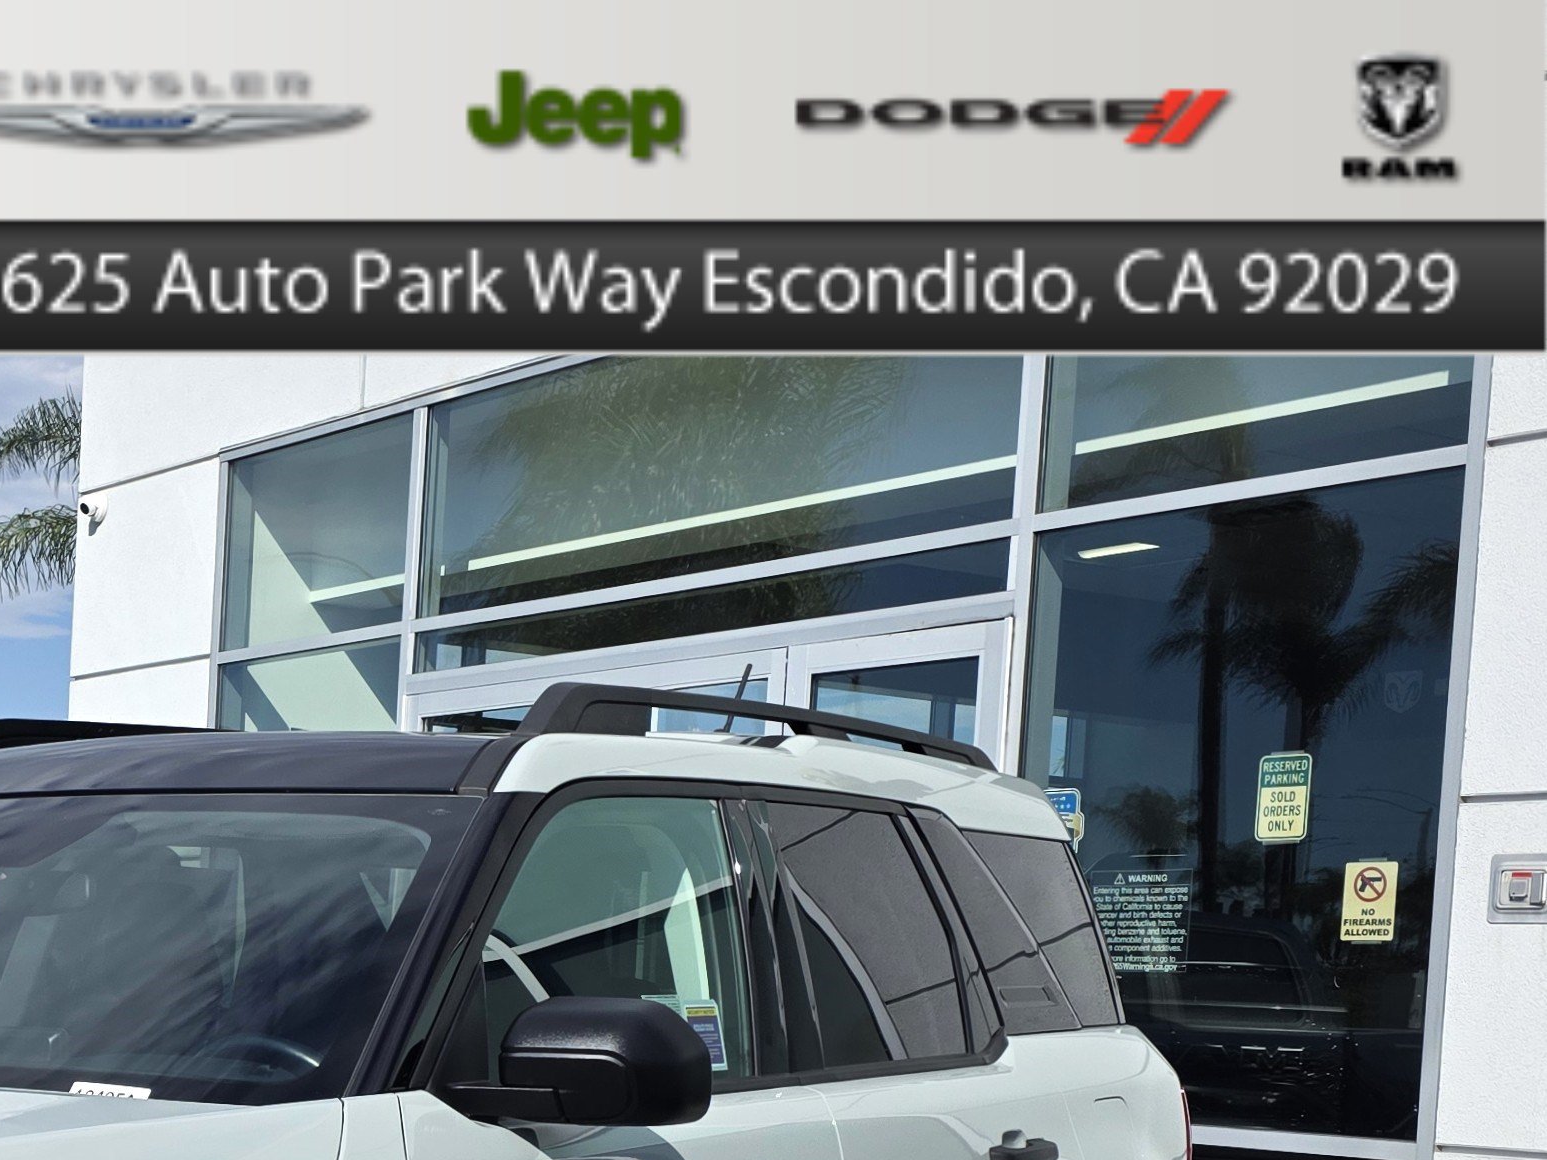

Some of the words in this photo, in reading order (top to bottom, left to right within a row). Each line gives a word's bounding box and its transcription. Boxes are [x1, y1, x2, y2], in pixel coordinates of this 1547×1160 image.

[1262, 759, 1308, 773] RESERVED
[1264, 773, 1305, 785] PARKING
[1270, 791, 1296, 803] SOLD
[1263, 804, 1301, 817] ORDERS
[1267, 819, 1295, 832] ONLY
[1128, 874, 1168, 883] WARNING
[1093, 887, 1120, 896] Entering
[1361, 908, 1375, 916] NO
[1343, 918, 1392, 927] FIREARMS
[1344, 928, 1390, 936] ALLOWED
